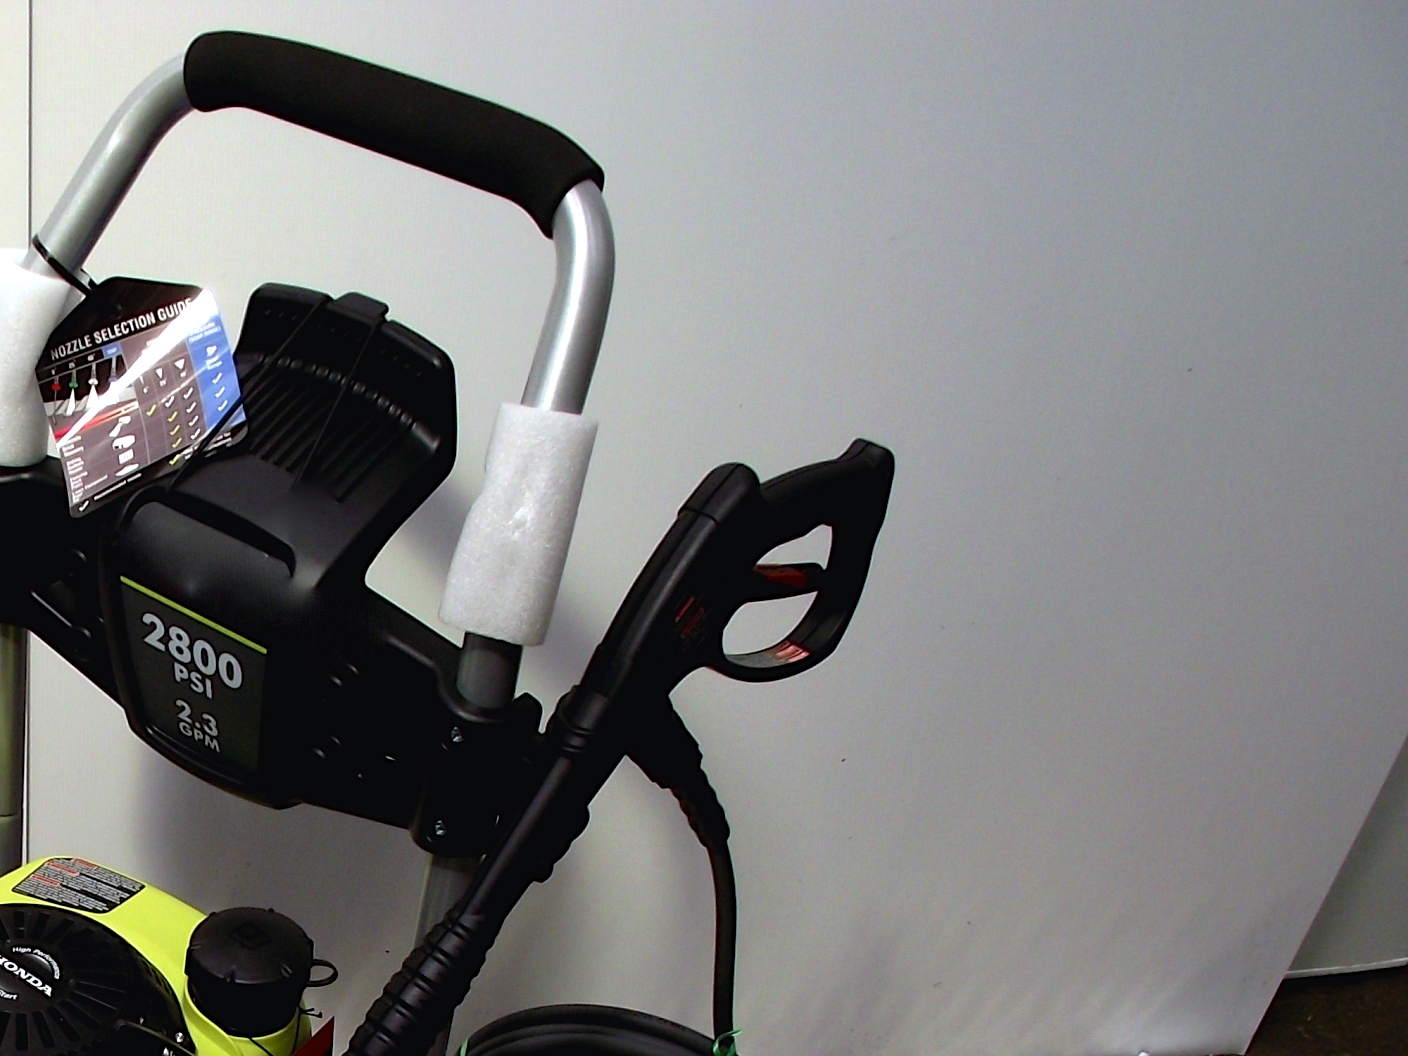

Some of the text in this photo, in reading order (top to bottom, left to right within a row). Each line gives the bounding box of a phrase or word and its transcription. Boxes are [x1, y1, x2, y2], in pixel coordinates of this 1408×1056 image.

[51, 334, 92, 360] NOZZLE
[93, 312, 156, 344] SELECTION
[142, 613, 243, 689] 2800
[173, 662, 213, 699] PSI
[175, 699, 219, 737] 2.3
[179, 722, 220, 753] GPM
